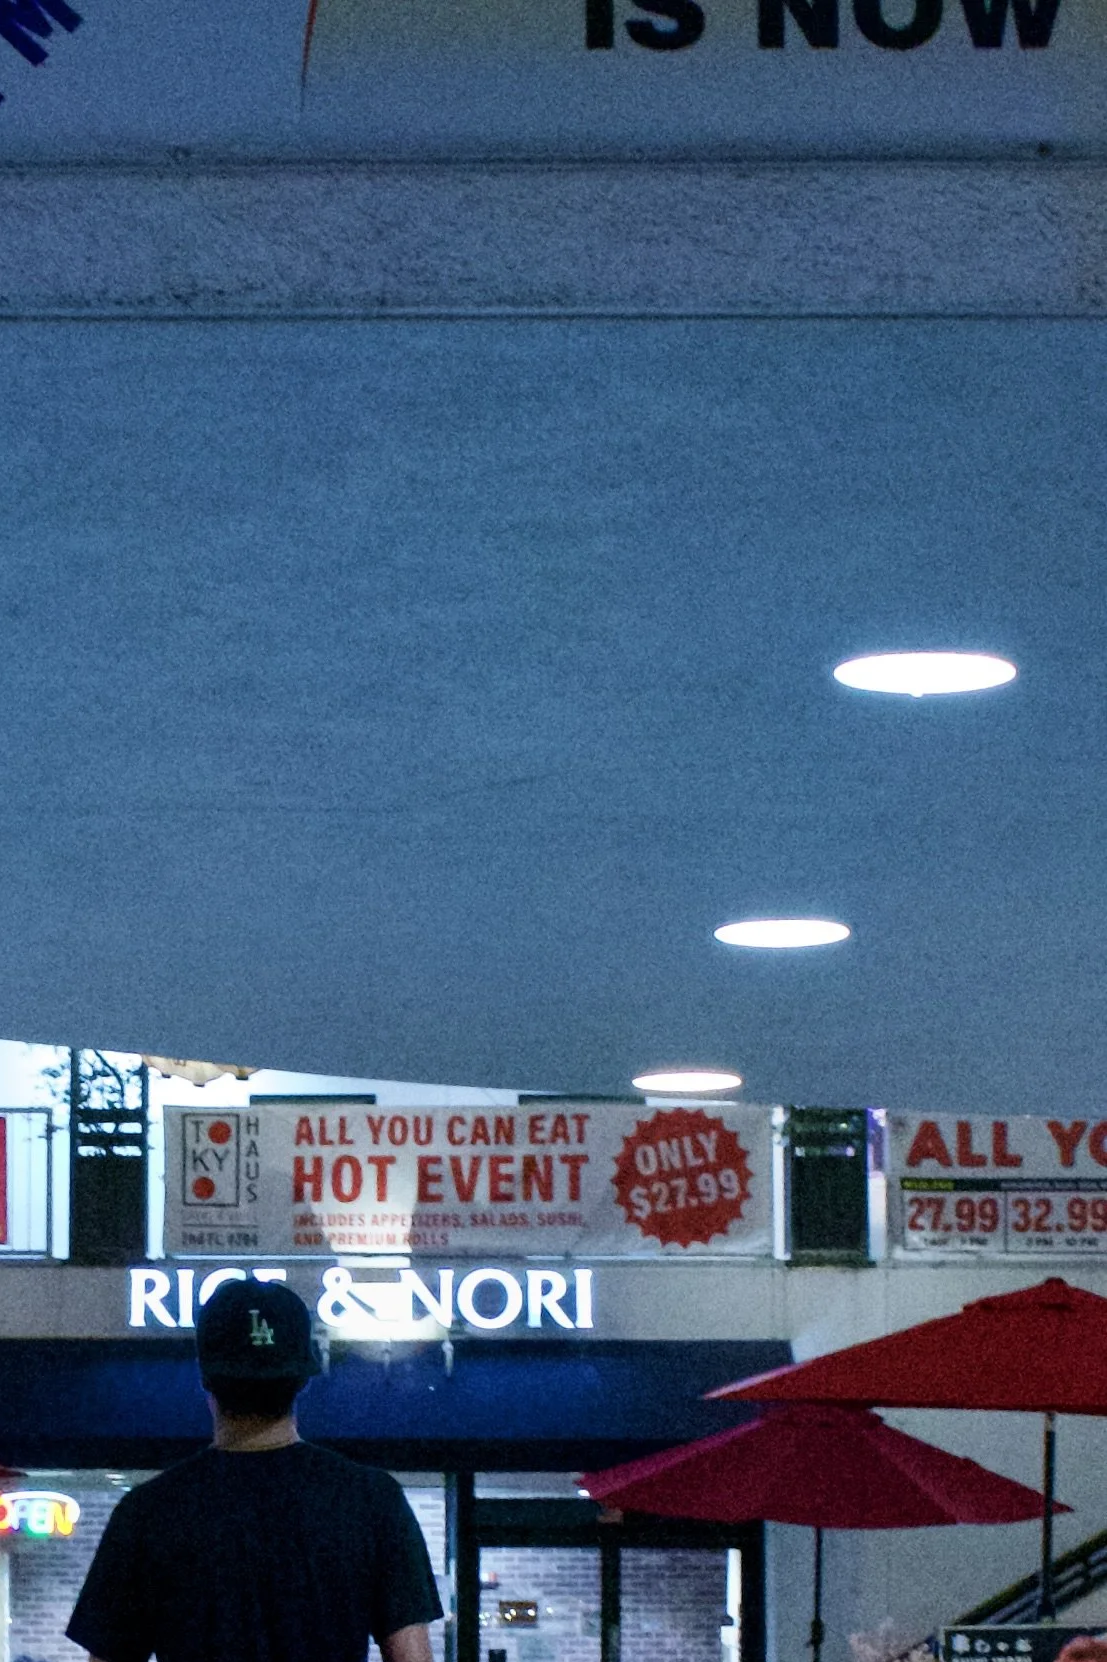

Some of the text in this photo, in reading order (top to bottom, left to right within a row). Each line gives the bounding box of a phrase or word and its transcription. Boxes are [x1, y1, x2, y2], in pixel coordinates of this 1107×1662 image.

[294, 1113, 590, 1146] ALL YOU CAN EAT
[906, 1120, 1023, 1168] ALL
[635, 1130, 718, 1176] ONLY
[294, 1154, 590, 1203] HOT EVENT
[628, 1168, 741, 1220] $27.99
[908, 1196, 999, 1233] 27.99
[293, 1232, 323, 1246] AND
[129, 1266, 593, 1329] RIC & NORI
[248, 1309, 274, 1346] LA
